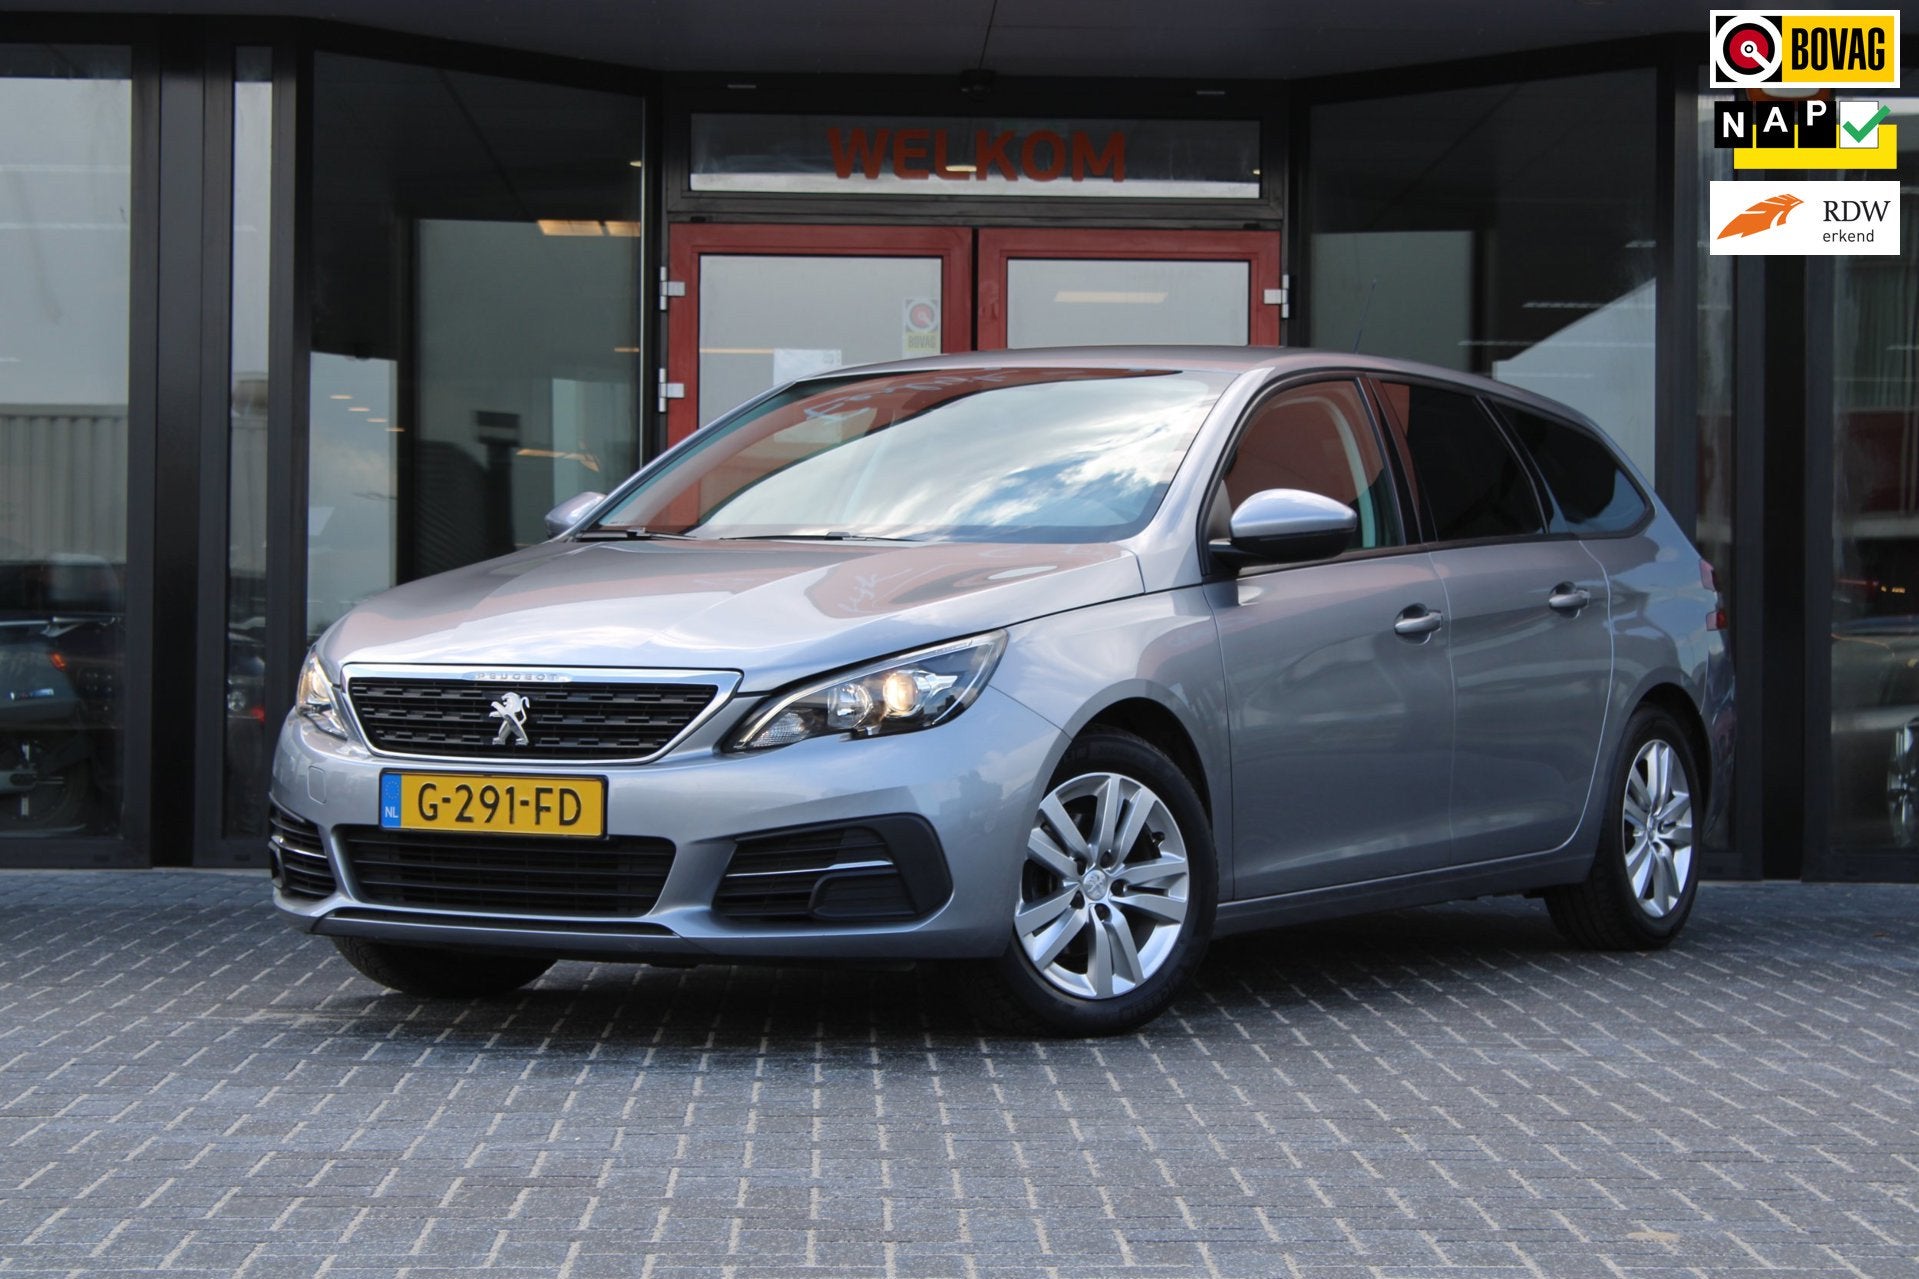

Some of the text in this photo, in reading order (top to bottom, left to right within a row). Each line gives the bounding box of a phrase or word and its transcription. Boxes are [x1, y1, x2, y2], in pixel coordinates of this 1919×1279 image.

[827, 127, 1126, 183] WELKOM
[907, 333, 936, 349] BOVAG
[476, 672, 559, 681] PEUGEOT
[384, 806, 399, 819] NL
[417, 782, 582, 827] G-291-FD
